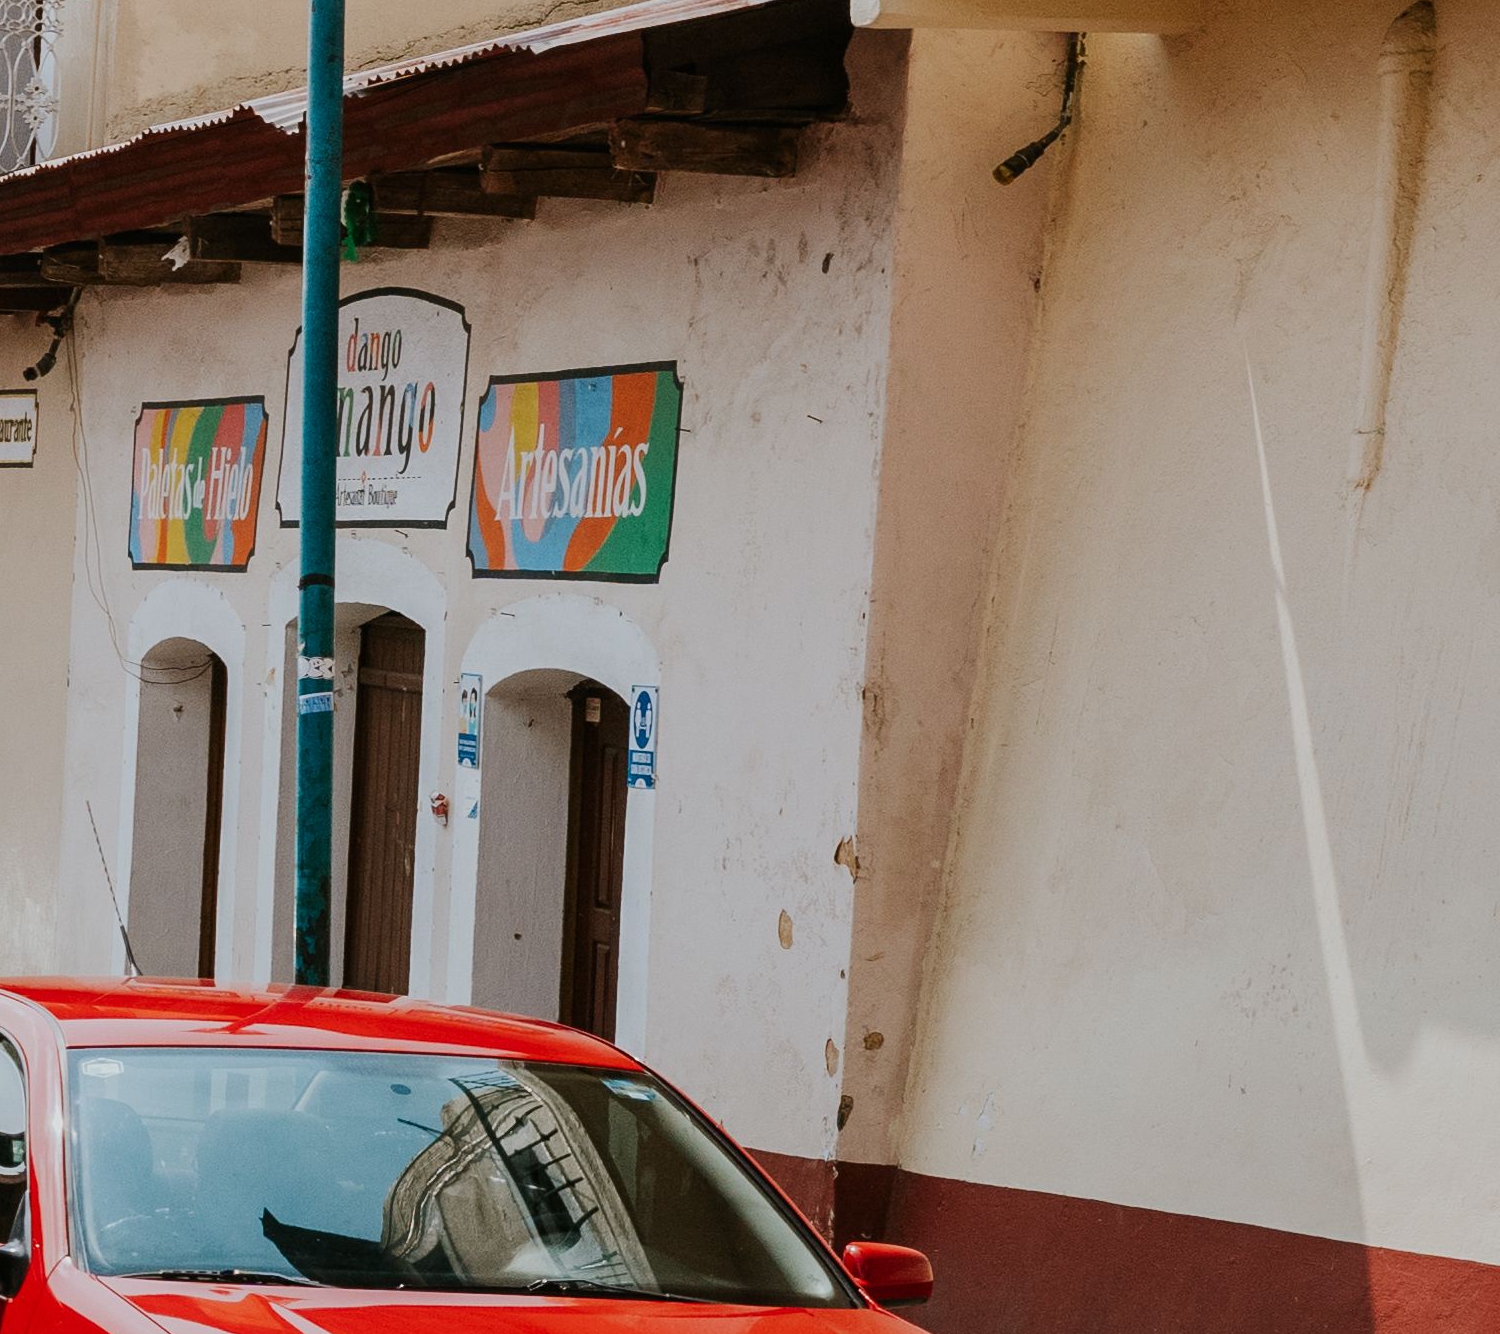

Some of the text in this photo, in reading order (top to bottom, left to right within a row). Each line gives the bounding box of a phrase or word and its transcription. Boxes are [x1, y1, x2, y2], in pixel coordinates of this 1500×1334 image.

[347, 318, 402, 381] dango
[138, 446, 253, 520] Paletas de Hielo
[495, 425, 651, 525] Artesanías
